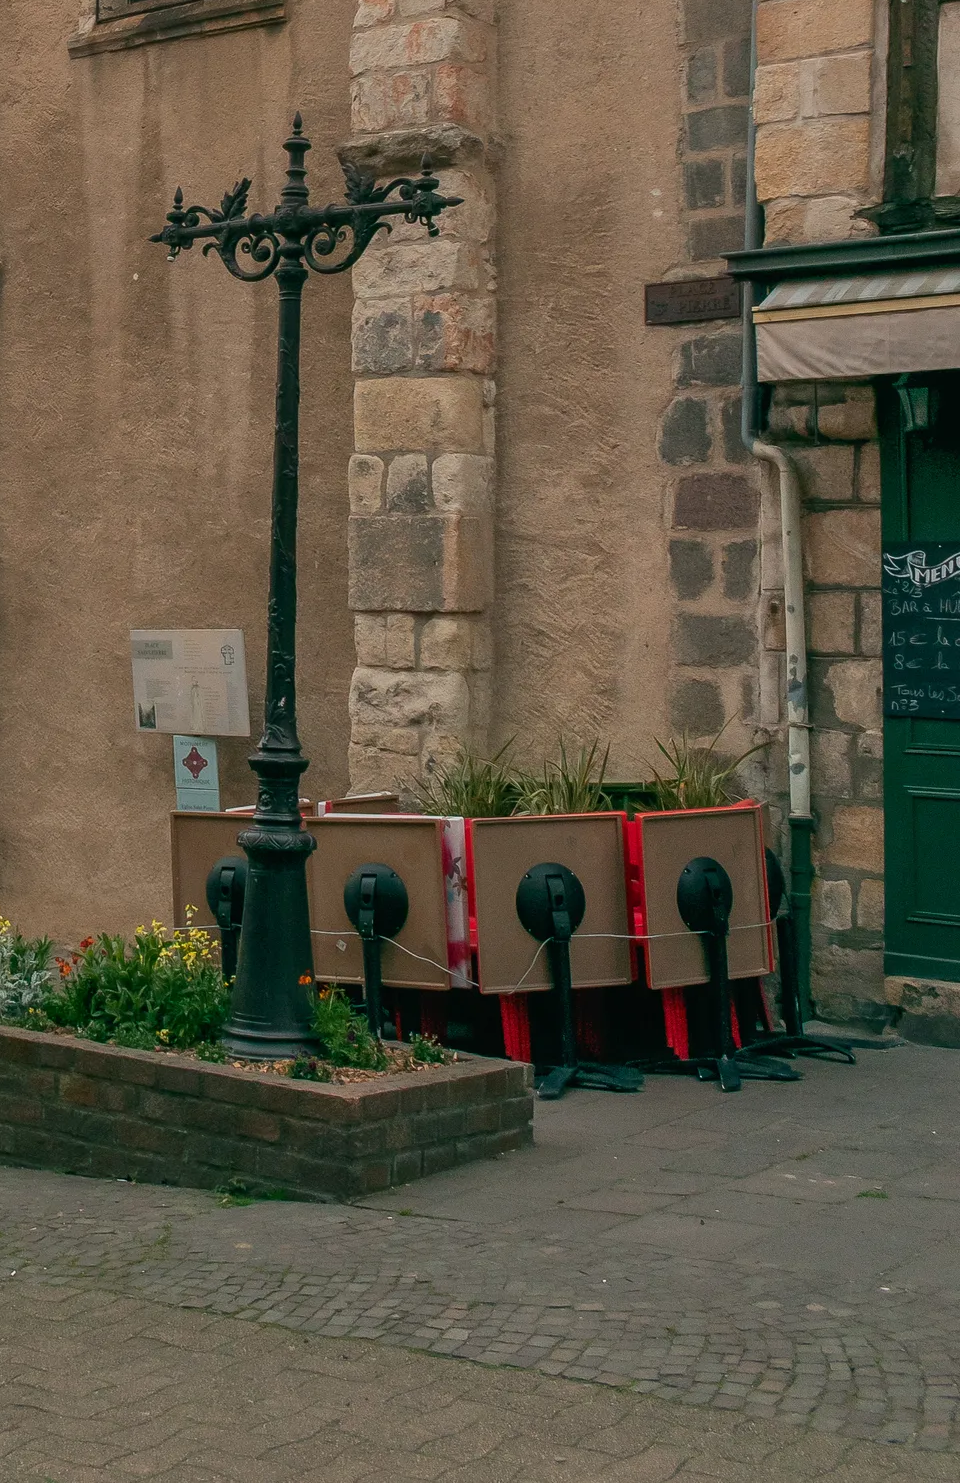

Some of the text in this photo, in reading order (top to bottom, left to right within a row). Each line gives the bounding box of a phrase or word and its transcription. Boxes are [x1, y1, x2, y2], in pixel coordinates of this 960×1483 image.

[889, 598, 919, 616] BAR
[922, 602, 933, 613] à
[890, 684, 924, 698] Tous
